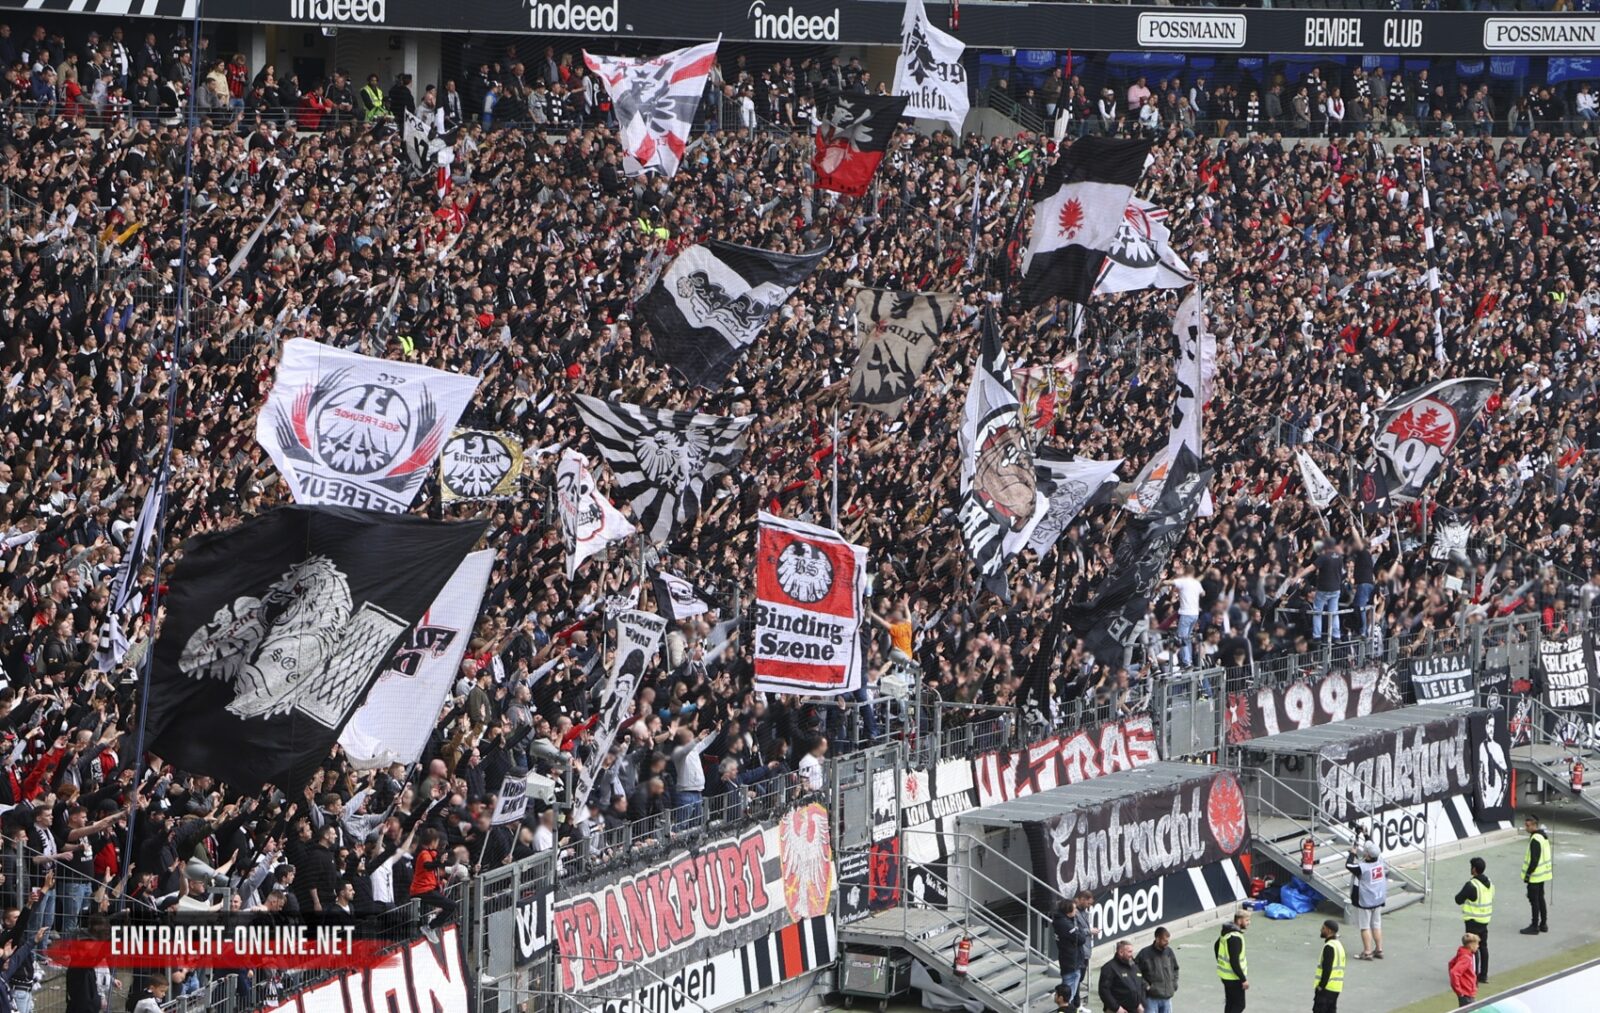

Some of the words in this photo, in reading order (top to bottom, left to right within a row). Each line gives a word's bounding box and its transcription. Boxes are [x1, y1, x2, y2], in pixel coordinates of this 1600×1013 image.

[530, 0, 618, 32] indeed
[754, 6, 840, 40] indeed
[1149, 19, 1236, 39] POSSMANN
[1305, 17, 1364, 48] BEMBEL
[1383, 18, 1423, 48] CLUB
[1497, 26, 1596, 43] POSSMANN
[755, 603, 844, 646] Binding
[758, 632, 835, 661] Szene
[1414, 654, 1467, 676] ULTRAS
[1257, 668, 1380, 737] 1997
[1421, 678, 1466, 699] NEVER
[975, 718, 1158, 808] ULTRAS
[931, 791, 974, 819] GUARDIA
[1048, 787, 1206, 898] Eintracht
[553, 828, 771, 994] FRANKFURT
[1088, 875, 1164, 948] ndeed
